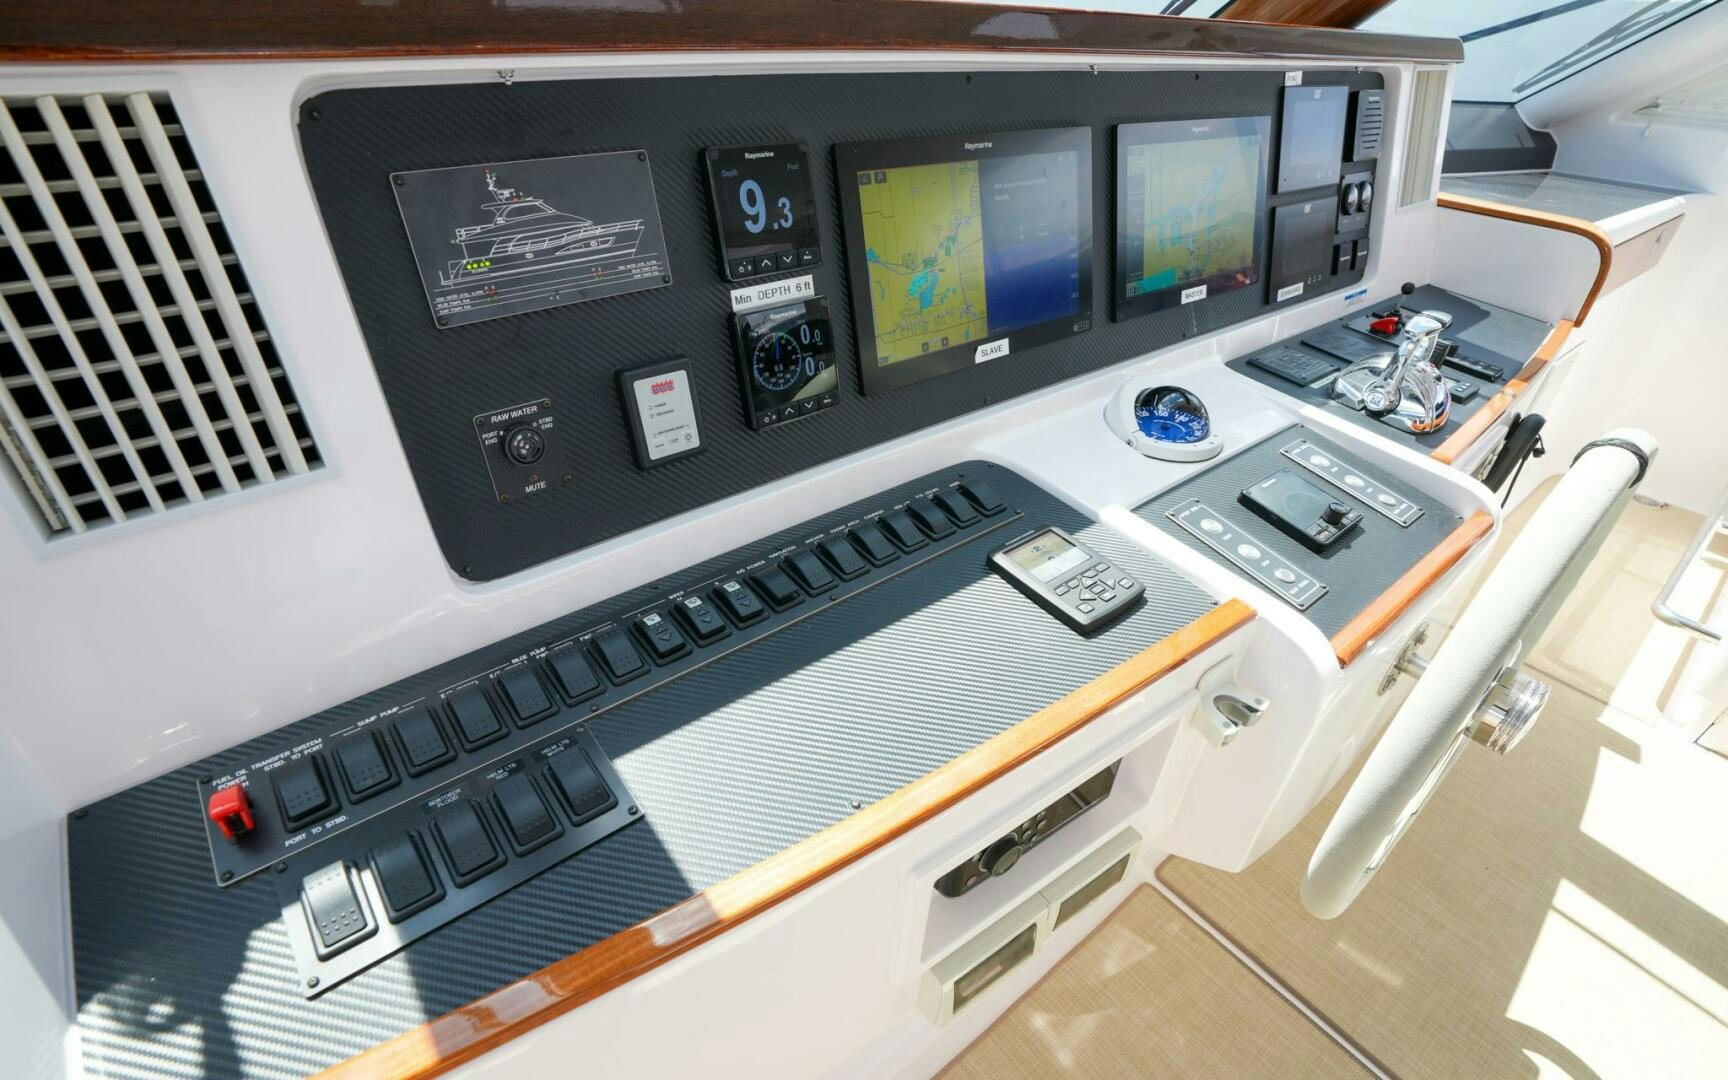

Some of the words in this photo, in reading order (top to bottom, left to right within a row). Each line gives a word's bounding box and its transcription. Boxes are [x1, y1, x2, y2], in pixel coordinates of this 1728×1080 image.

[744, 151, 775, 160] Raymarine
[735, 295, 752, 306] Min
[757, 285, 791, 301] DEPTH
[795, 282, 802, 292] 6
[804, 281, 812, 291] ft
[981, 344, 1003, 358] SLAVE
[491, 413, 510, 423] RAW
[510, 405, 538, 419] WATER
[482, 431, 498, 439] PORT
[525, 481, 546, 493] MUTE
[357, 715, 378, 727] SUMP
[380, 706, 400, 718] PUMP
[291, 752, 302, 761] TO
[303, 743, 324, 755] PORT
[212, 775, 233, 787] FUEL
[235, 769, 249, 777] OIL
[250, 750, 291, 771] TRANSFER
[293, 737, 323, 753] SYSTEM
[486, 768, 503, 779] HELM
[218, 775, 247, 790] POWER
[285, 832, 307, 847] PORT
[311, 826, 322, 835] TO
